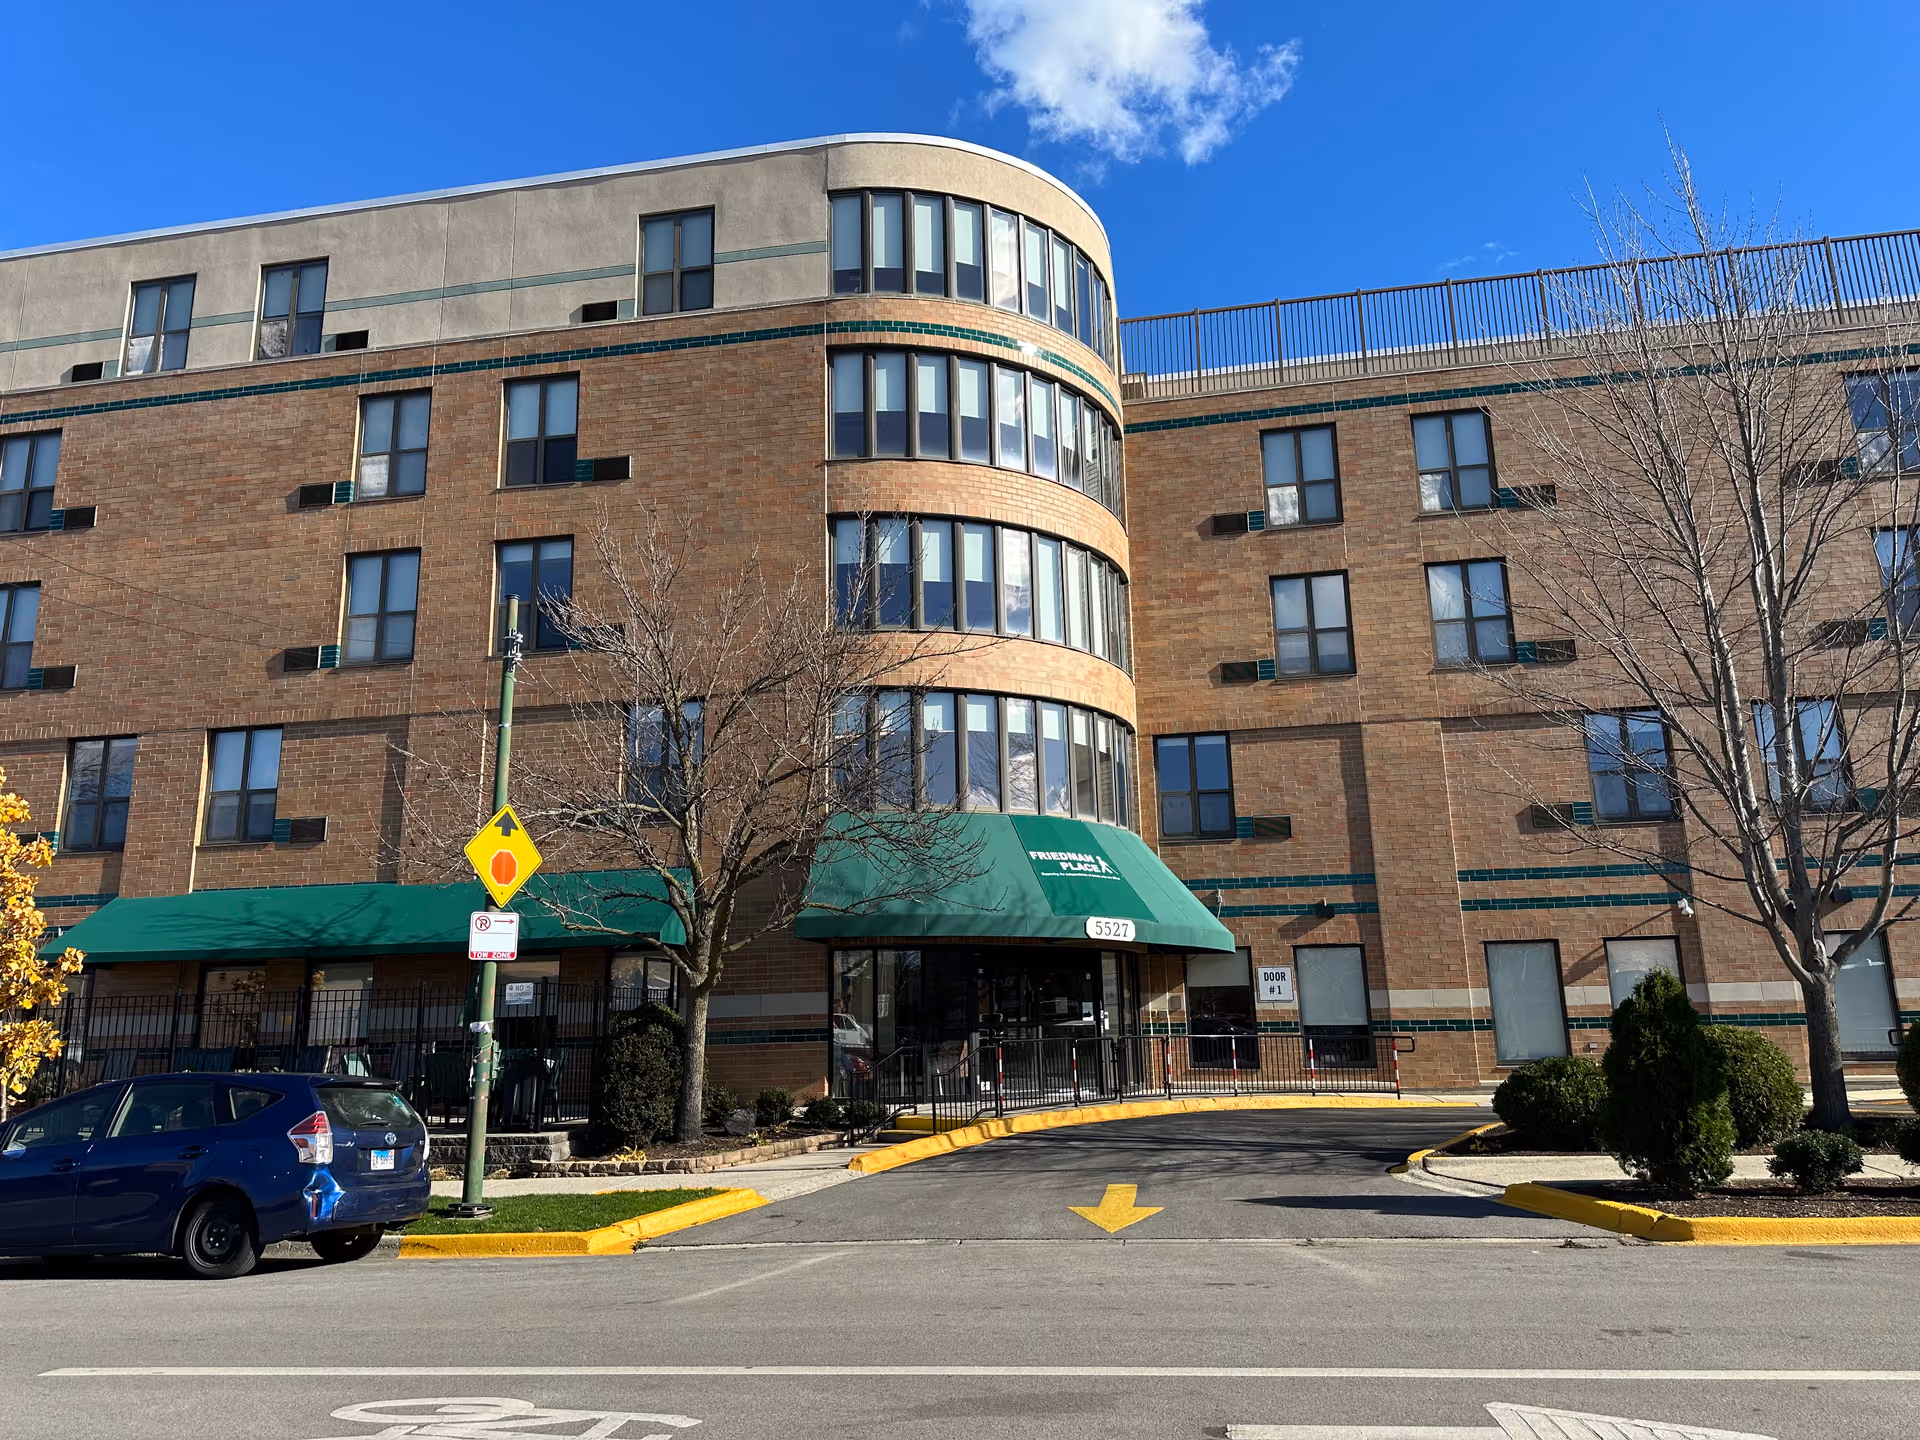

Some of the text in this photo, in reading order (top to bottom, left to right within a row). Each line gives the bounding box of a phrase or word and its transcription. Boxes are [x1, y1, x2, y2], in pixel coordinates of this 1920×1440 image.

[1029, 851, 1095, 863] FRIEDMAN
[1060, 861, 1101, 873] PLACE
[1095, 920, 1129, 938] 5527
[1263, 971, 1286, 982] DOOR
[515, 984, 524, 992] NO
